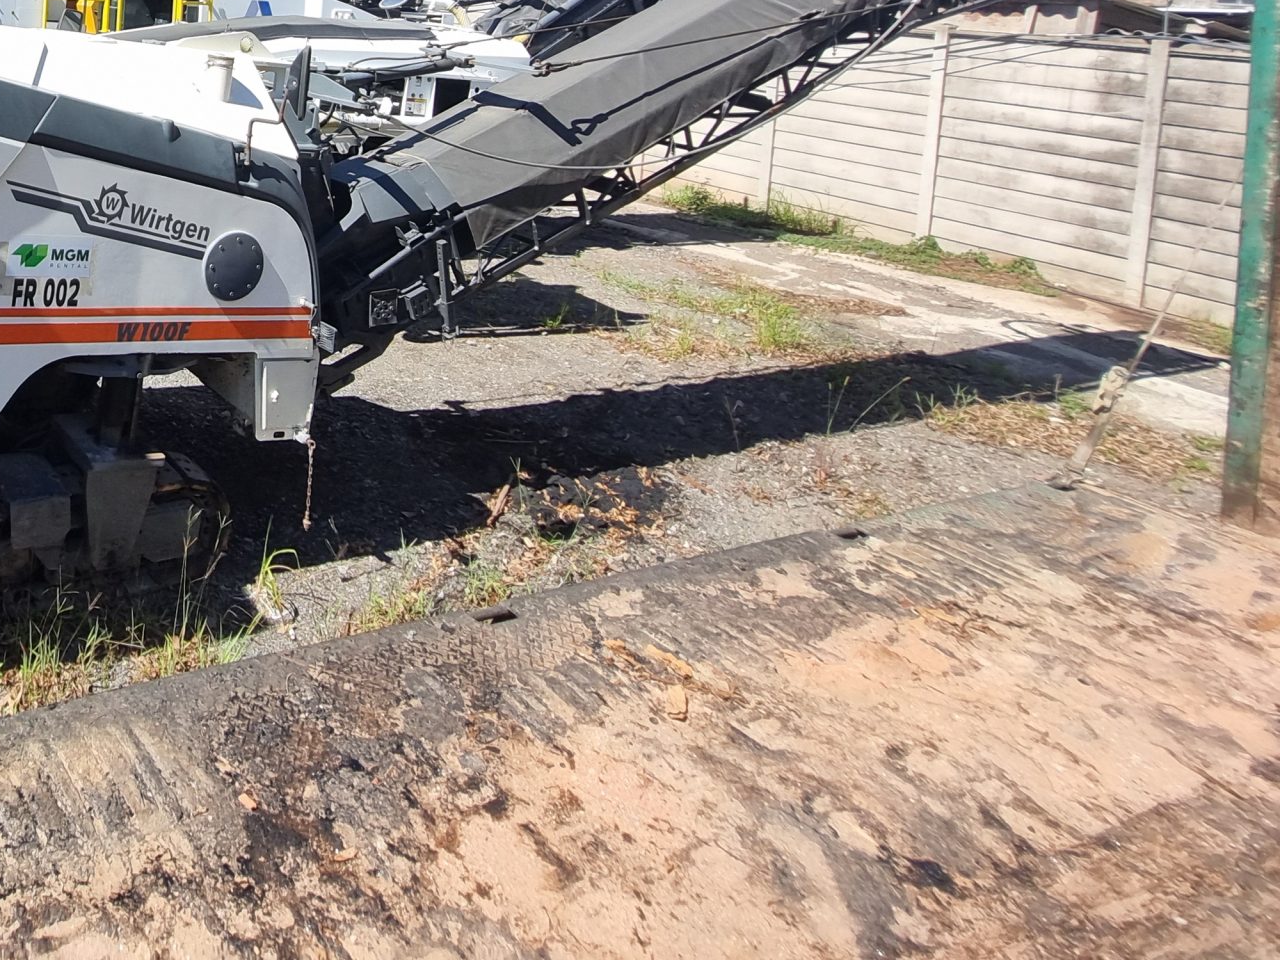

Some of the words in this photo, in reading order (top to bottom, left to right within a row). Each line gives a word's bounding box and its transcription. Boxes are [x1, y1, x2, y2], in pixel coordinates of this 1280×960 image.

[105, 196, 120, 211] W
[130, 203, 210, 241] Wirtgen
[51, 249, 90, 261] MGM
[12, 278, 37, 307] FR
[43, 278, 81, 307] 002
[117, 321, 192, 342] W100F
